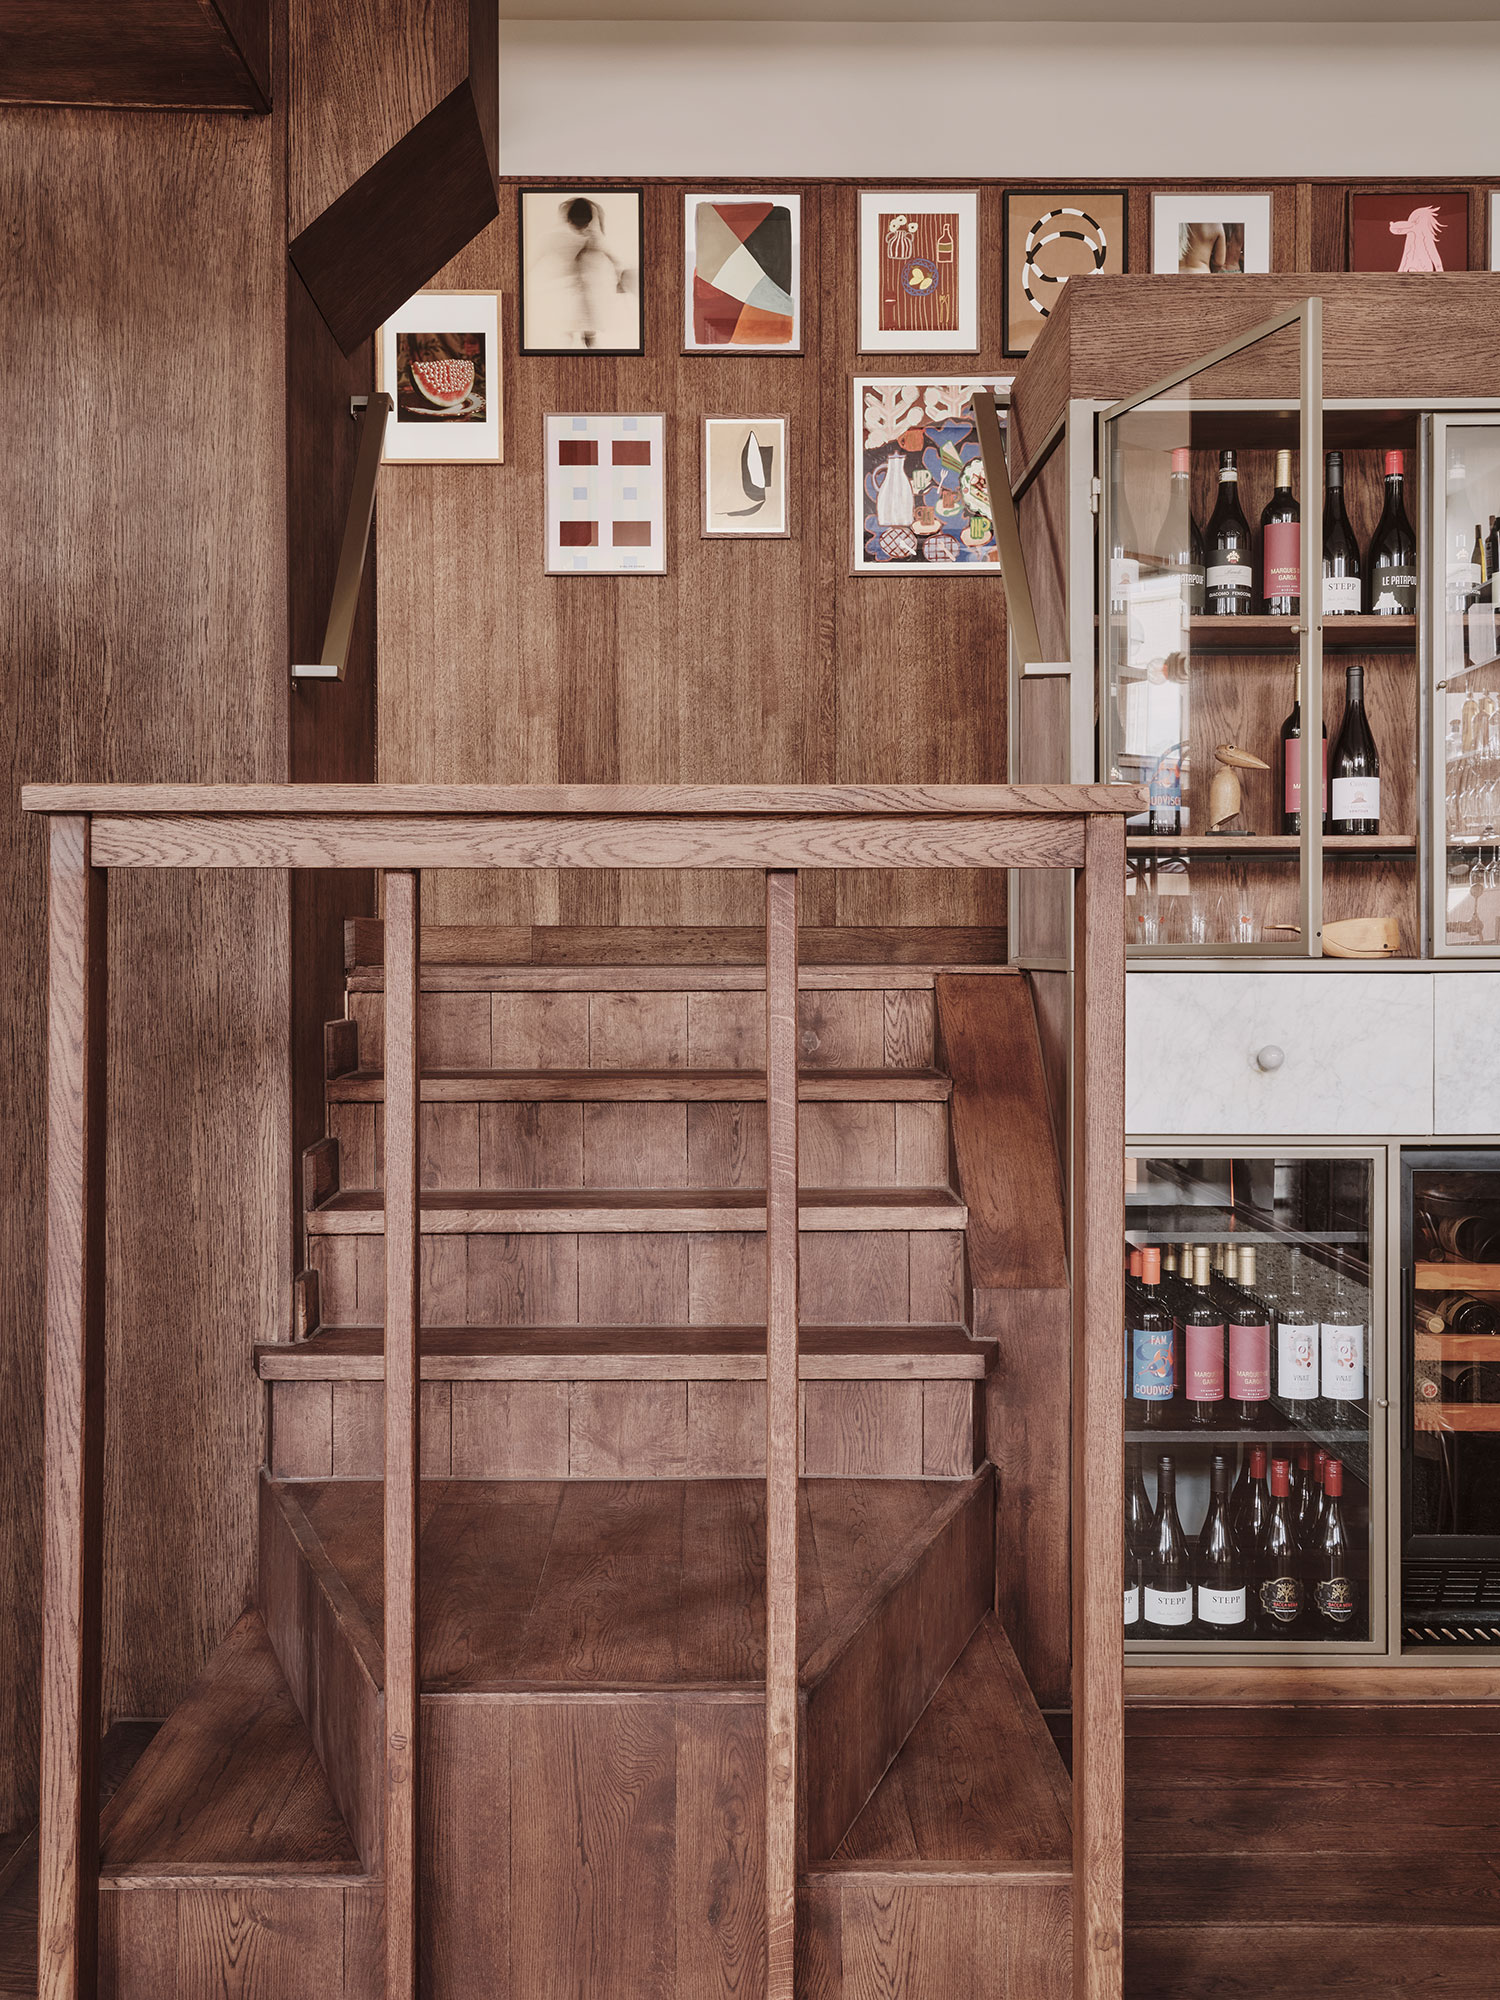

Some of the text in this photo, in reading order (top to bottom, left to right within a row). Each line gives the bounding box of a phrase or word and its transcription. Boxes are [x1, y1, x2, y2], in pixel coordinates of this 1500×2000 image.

[1382, 576, 1390, 586] LE
[1328, 583, 1356, 591] STEPP
[1157, 1597, 1187, 1605] STEPP
[1212, 1596, 1241, 1604] STEPP
